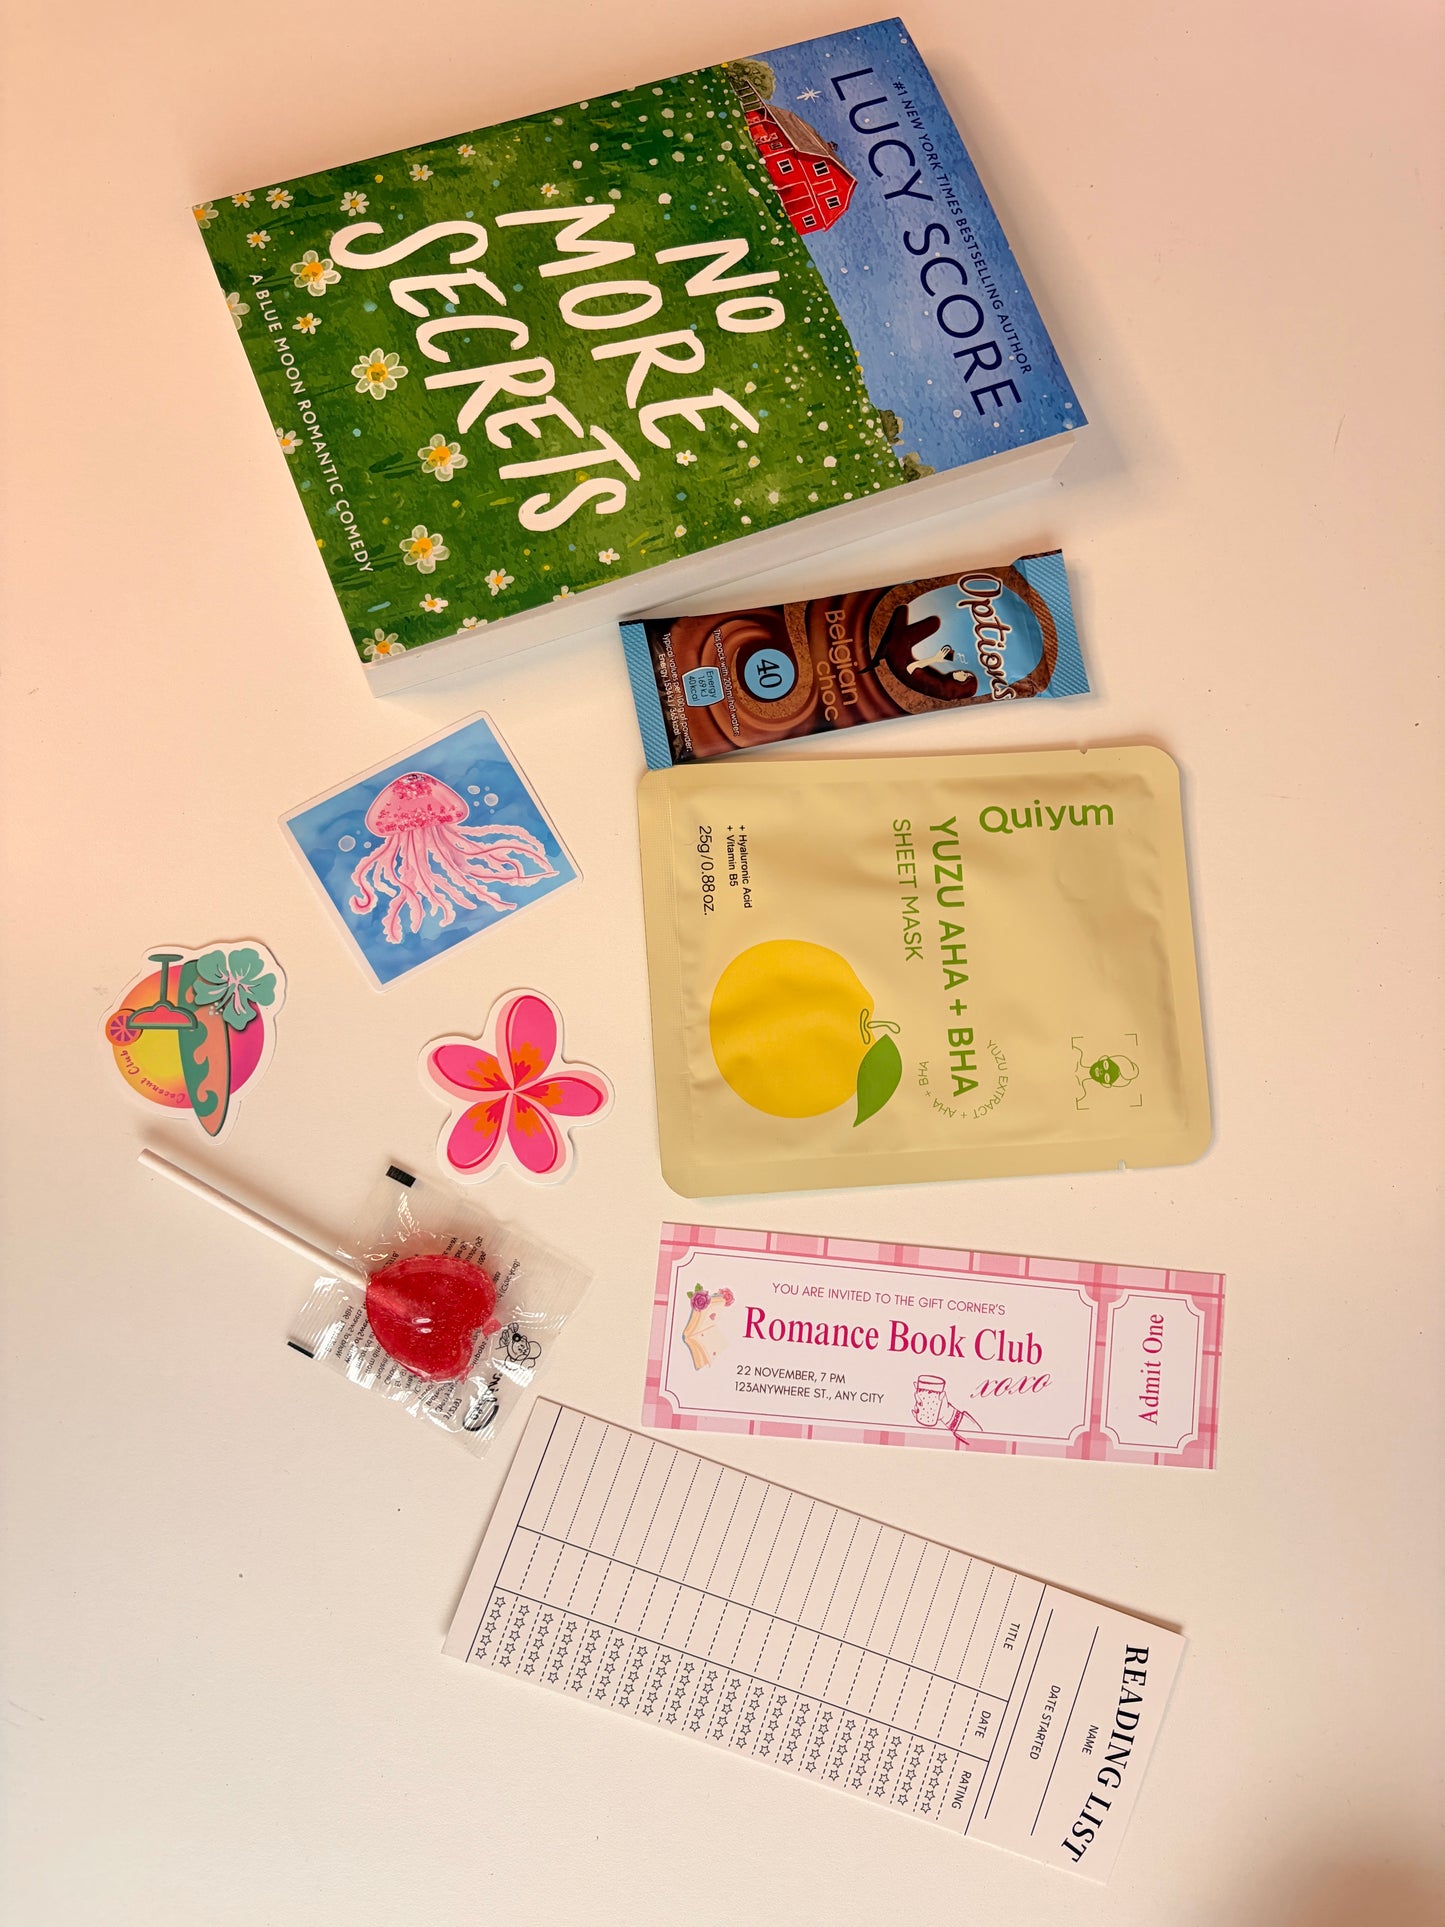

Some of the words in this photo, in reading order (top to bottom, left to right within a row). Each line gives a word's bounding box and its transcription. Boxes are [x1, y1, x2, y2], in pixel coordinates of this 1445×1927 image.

[831, 67, 934, 202] LUCY
[903, 223, 1023, 416] SCORE
[892, 81, 908, 96] #1
[901, 99, 925, 130] NEW
[918, 133, 943, 171] YORK
[936, 173, 963, 216] TIMES
[956, 218, 1004, 311] BESTSELLING
[997, 314, 1032, 375] AUTHOR
[249, 274, 264, 286] A
[654, 238, 786, 333] NO
[255, 289, 283, 333] BLUE
[494, 204, 760, 449] MORE
[273, 337, 306, 395] MOON
[329, 220, 641, 532] SECRETS
[297, 399, 344, 495] ROMANTIC
[335, 499, 374, 573] COMEDY
[716, 642, 725, 660] pack
[824, 609, 858, 706] Belgian
[956, 573, 1017, 701] Options
[657, 653, 668, 678] Energy
[662, 633, 674, 658] Typical
[669, 659, 678, 681] values
[680, 713, 686, 722] of
[705, 670, 718, 698] Energy
[756, 658, 783, 689] 40
[816, 661, 839, 722] choc
[979, 799, 1114, 834] Quiyum
[726, 834, 737, 870] Vitamin
[737, 834, 750, 885] Hyaluronic
[892, 819, 918, 889] SHEET
[929, 816, 965, 908] YUZU
[728, 873, 739, 887] B5
[742, 887, 752, 909] Acid
[901, 896, 924, 962] MASK
[938, 920, 969, 991] AHA
[949, 998, 968, 1016] +
[120, 1050, 140, 1075] Club
[918, 1060, 930, 1086] BHA
[947, 1028, 979, 1097] BHA
[987, 1040, 1008, 1071] YUZU
[933, 1098, 957, 1118] AHA
[972, 1075, 1009, 1120] EXTRACT
[772, 1282, 799, 1296] YOU
[802, 1285, 825, 1298] ARE
[828, 1288, 872, 1303] INVITED
[875, 1292, 891, 1305] TO
[894, 1294, 915, 1307] THE
[918, 1296, 945, 1310] GIFT
[947, 1300, 1006, 1316] CORNER'S
[742, 1306, 879, 1350] Romance
[886, 1319, 967, 1358] Book
[974, 1328, 1043, 1365] Club
[1142, 1313, 1165, 1354] One
[735, 1381, 811, 1398] 123ANYWHERE
[813, 1388, 832, 1401] ST.,
[834, 1390, 857, 1401] ANY
[860, 1392, 885, 1404] CITY
[736, 1364, 751, 1376] 22
[754, 1366, 817, 1383] NOVEMBER,
[820, 1372, 827, 1383] 7
[829, 1373, 846, 1384] PM
[969, 1373, 1053, 1399] xoxo
[1138, 1360, 1162, 1426] Admit
[1003, 1622, 1020, 1651] TITLE
[1043, 1684, 1061, 1713] DATE
[1096, 1643, 1150, 1790] READING
[974, 1710, 992, 1739] DATE
[1029, 1712, 1053, 1760] STARTED
[1081, 1724, 1099, 1755] NAME
[951, 1770, 972, 1811] RATING
[1061, 1791, 1112, 1863] LIST
